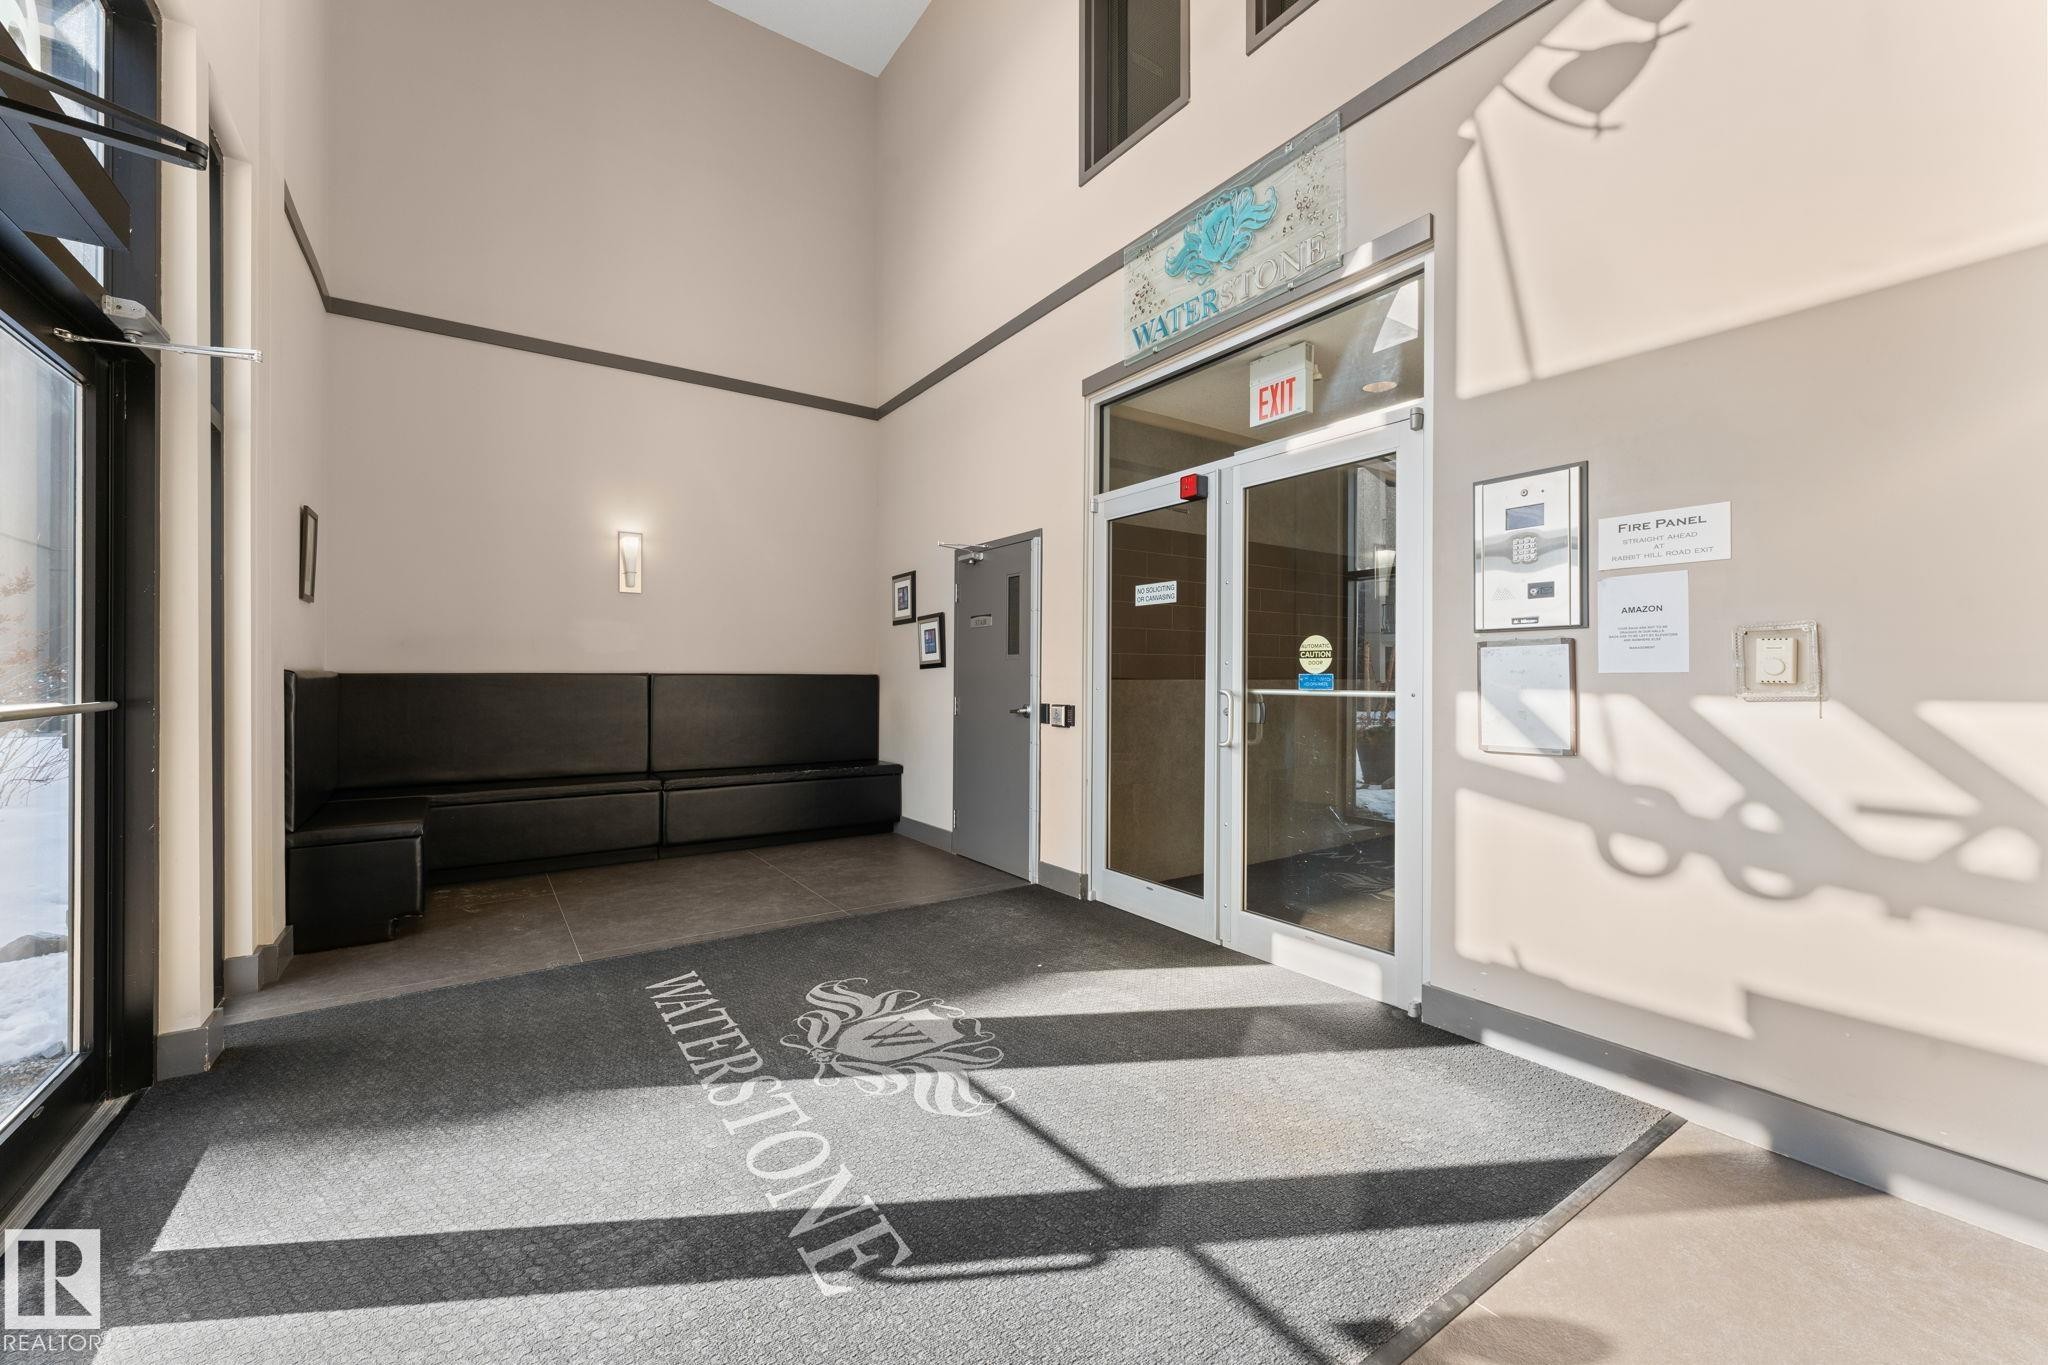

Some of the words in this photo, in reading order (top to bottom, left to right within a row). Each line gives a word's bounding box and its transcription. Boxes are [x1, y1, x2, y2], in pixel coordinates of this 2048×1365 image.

[1131, 231, 1326, 350] WATERSTONE
[1258, 377, 1296, 421] EXIT
[1618, 522, 1651, 533] FIRE
[1655, 515, 1707, 528] PANEL
[1622, 535, 1664, 545] STRAIGHT
[1667, 531, 1698, 540] AHEAD
[1611, 553, 1641, 562] RABBIT
[1643, 551, 1662, 559] HILL
[1665, 549, 1691, 557] ROAD
[1694, 546, 1714, 554] EXIT
[1137, 587, 1145, 595] NO
[1145, 584, 1175, 594] SOLICITING
[1621, 605, 1663, 614] AMAZON
[645, 970, 913, 1297] WATERSTONE
